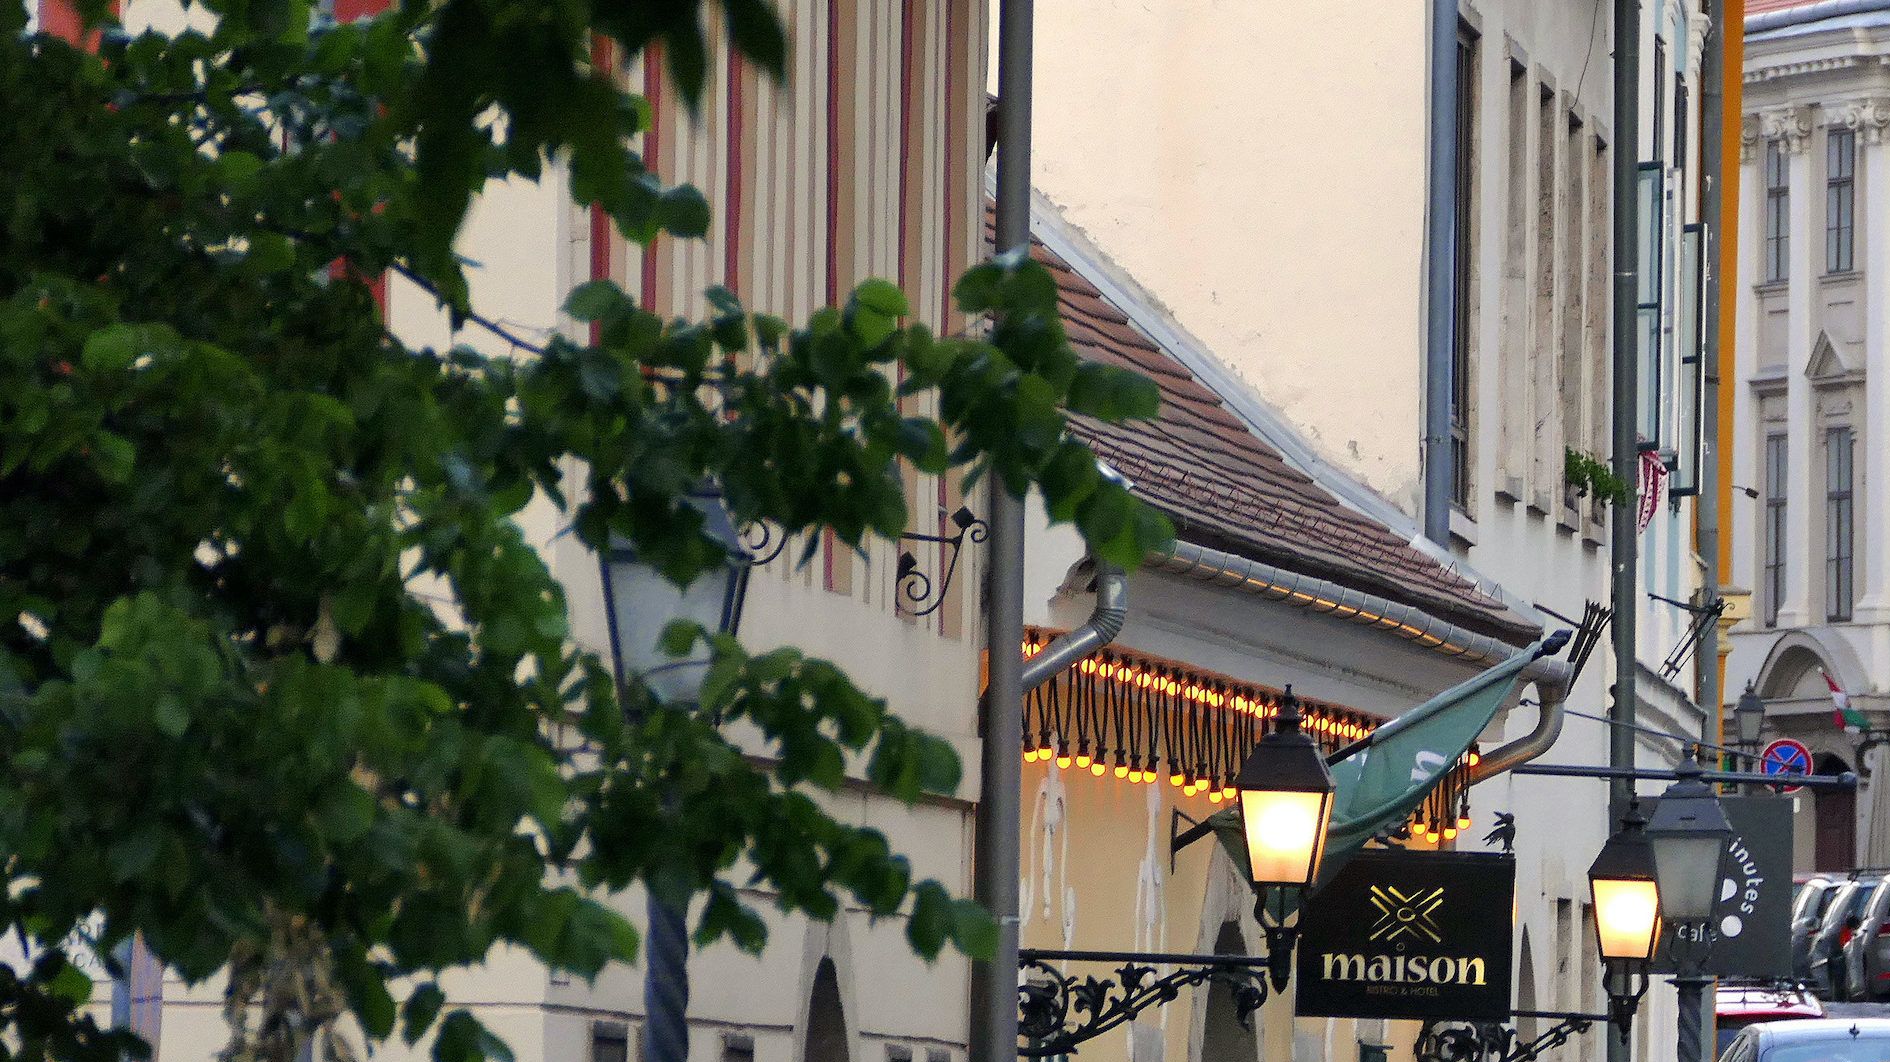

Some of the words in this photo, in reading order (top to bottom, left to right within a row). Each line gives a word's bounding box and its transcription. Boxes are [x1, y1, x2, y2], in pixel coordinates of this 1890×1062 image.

[1728, 836, 1763, 914] inutes
[1321, 943, 1487, 986] maison
[1410, 986, 1439, 996] HOTEL
